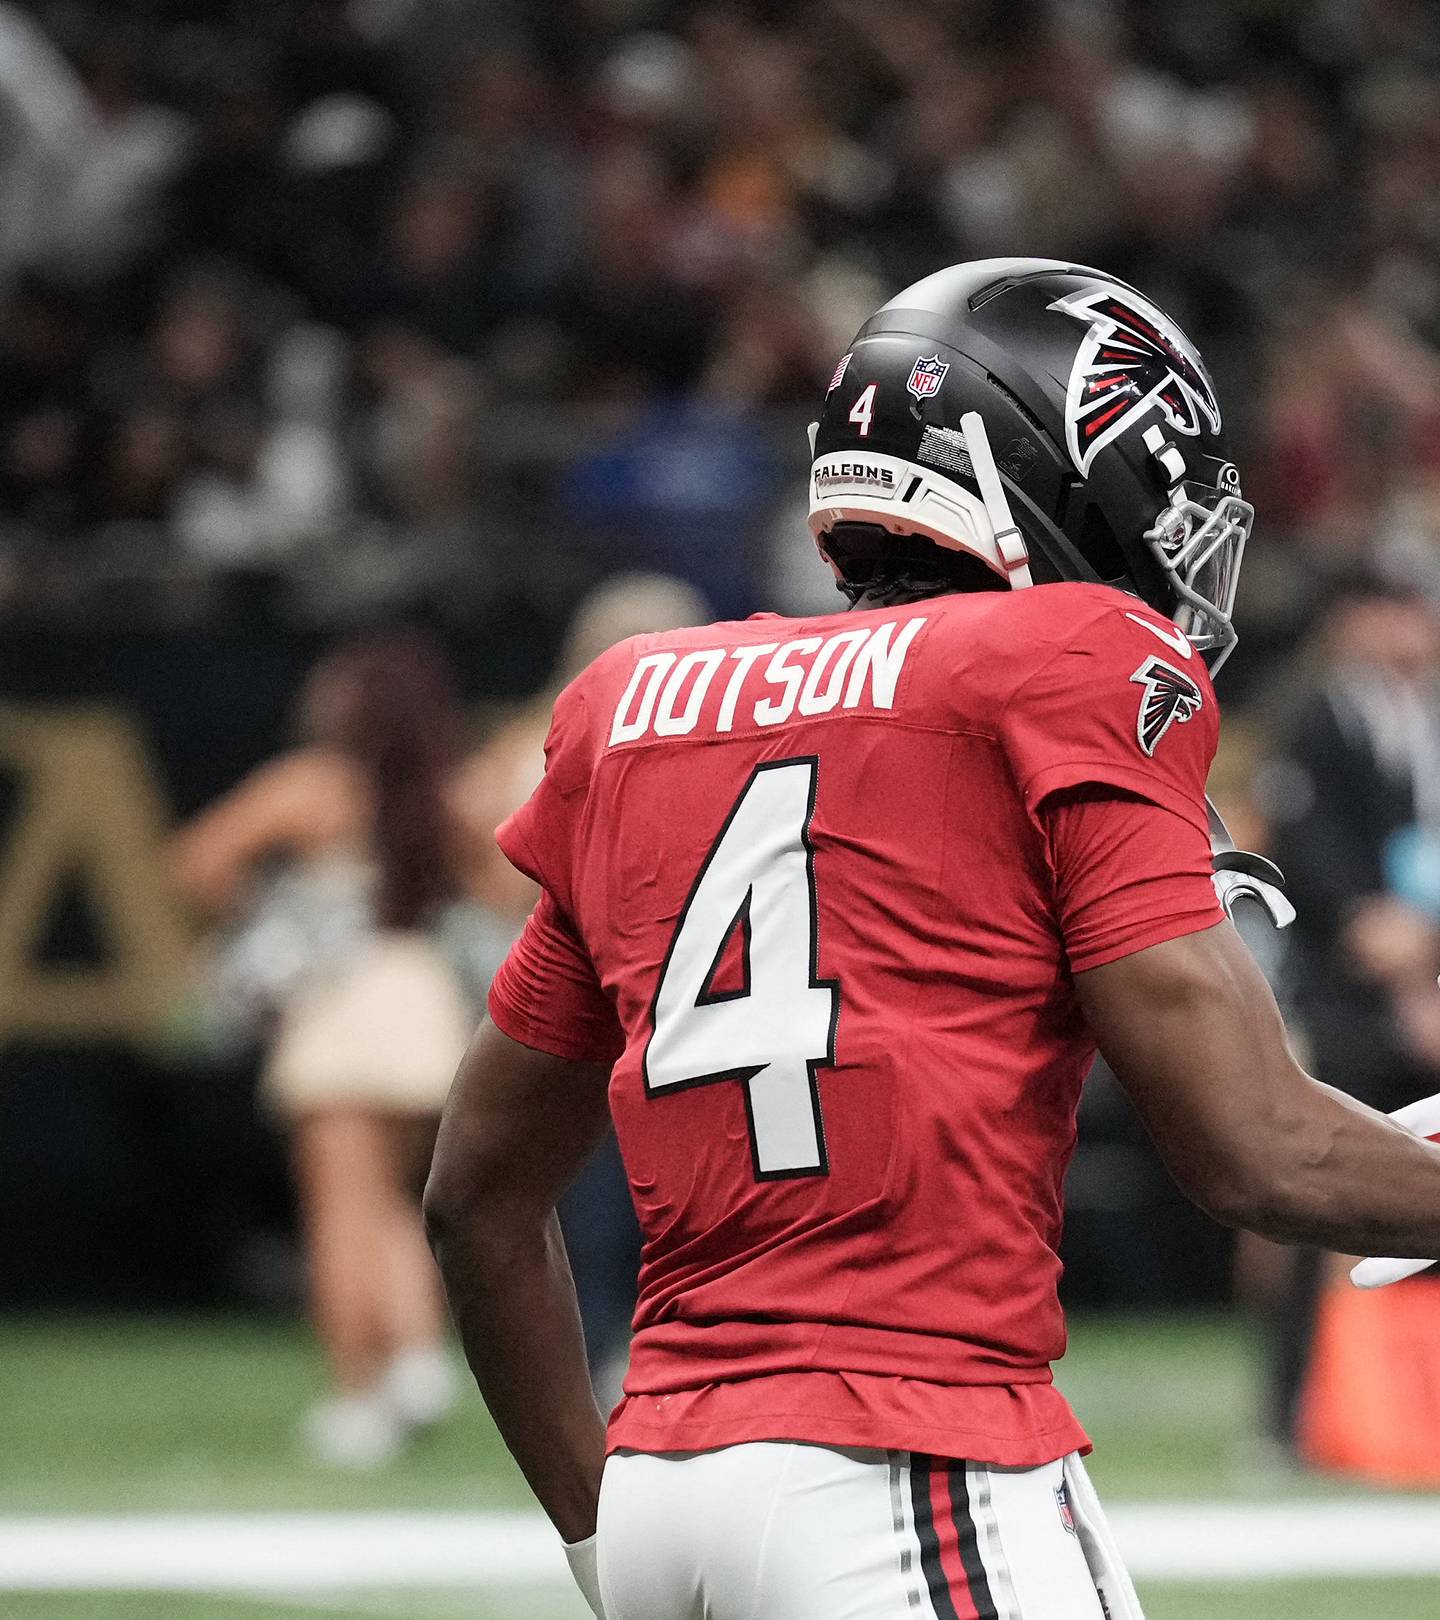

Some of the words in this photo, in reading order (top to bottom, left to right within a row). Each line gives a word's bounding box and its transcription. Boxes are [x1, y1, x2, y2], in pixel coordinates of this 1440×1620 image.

[911, 372, 936, 392] NFL
[848, 384, 878, 437] 4
[814, 463, 894, 483] FALCONS
[607, 616, 928, 748] DOTSON
[642, 753, 840, 1183] 4
